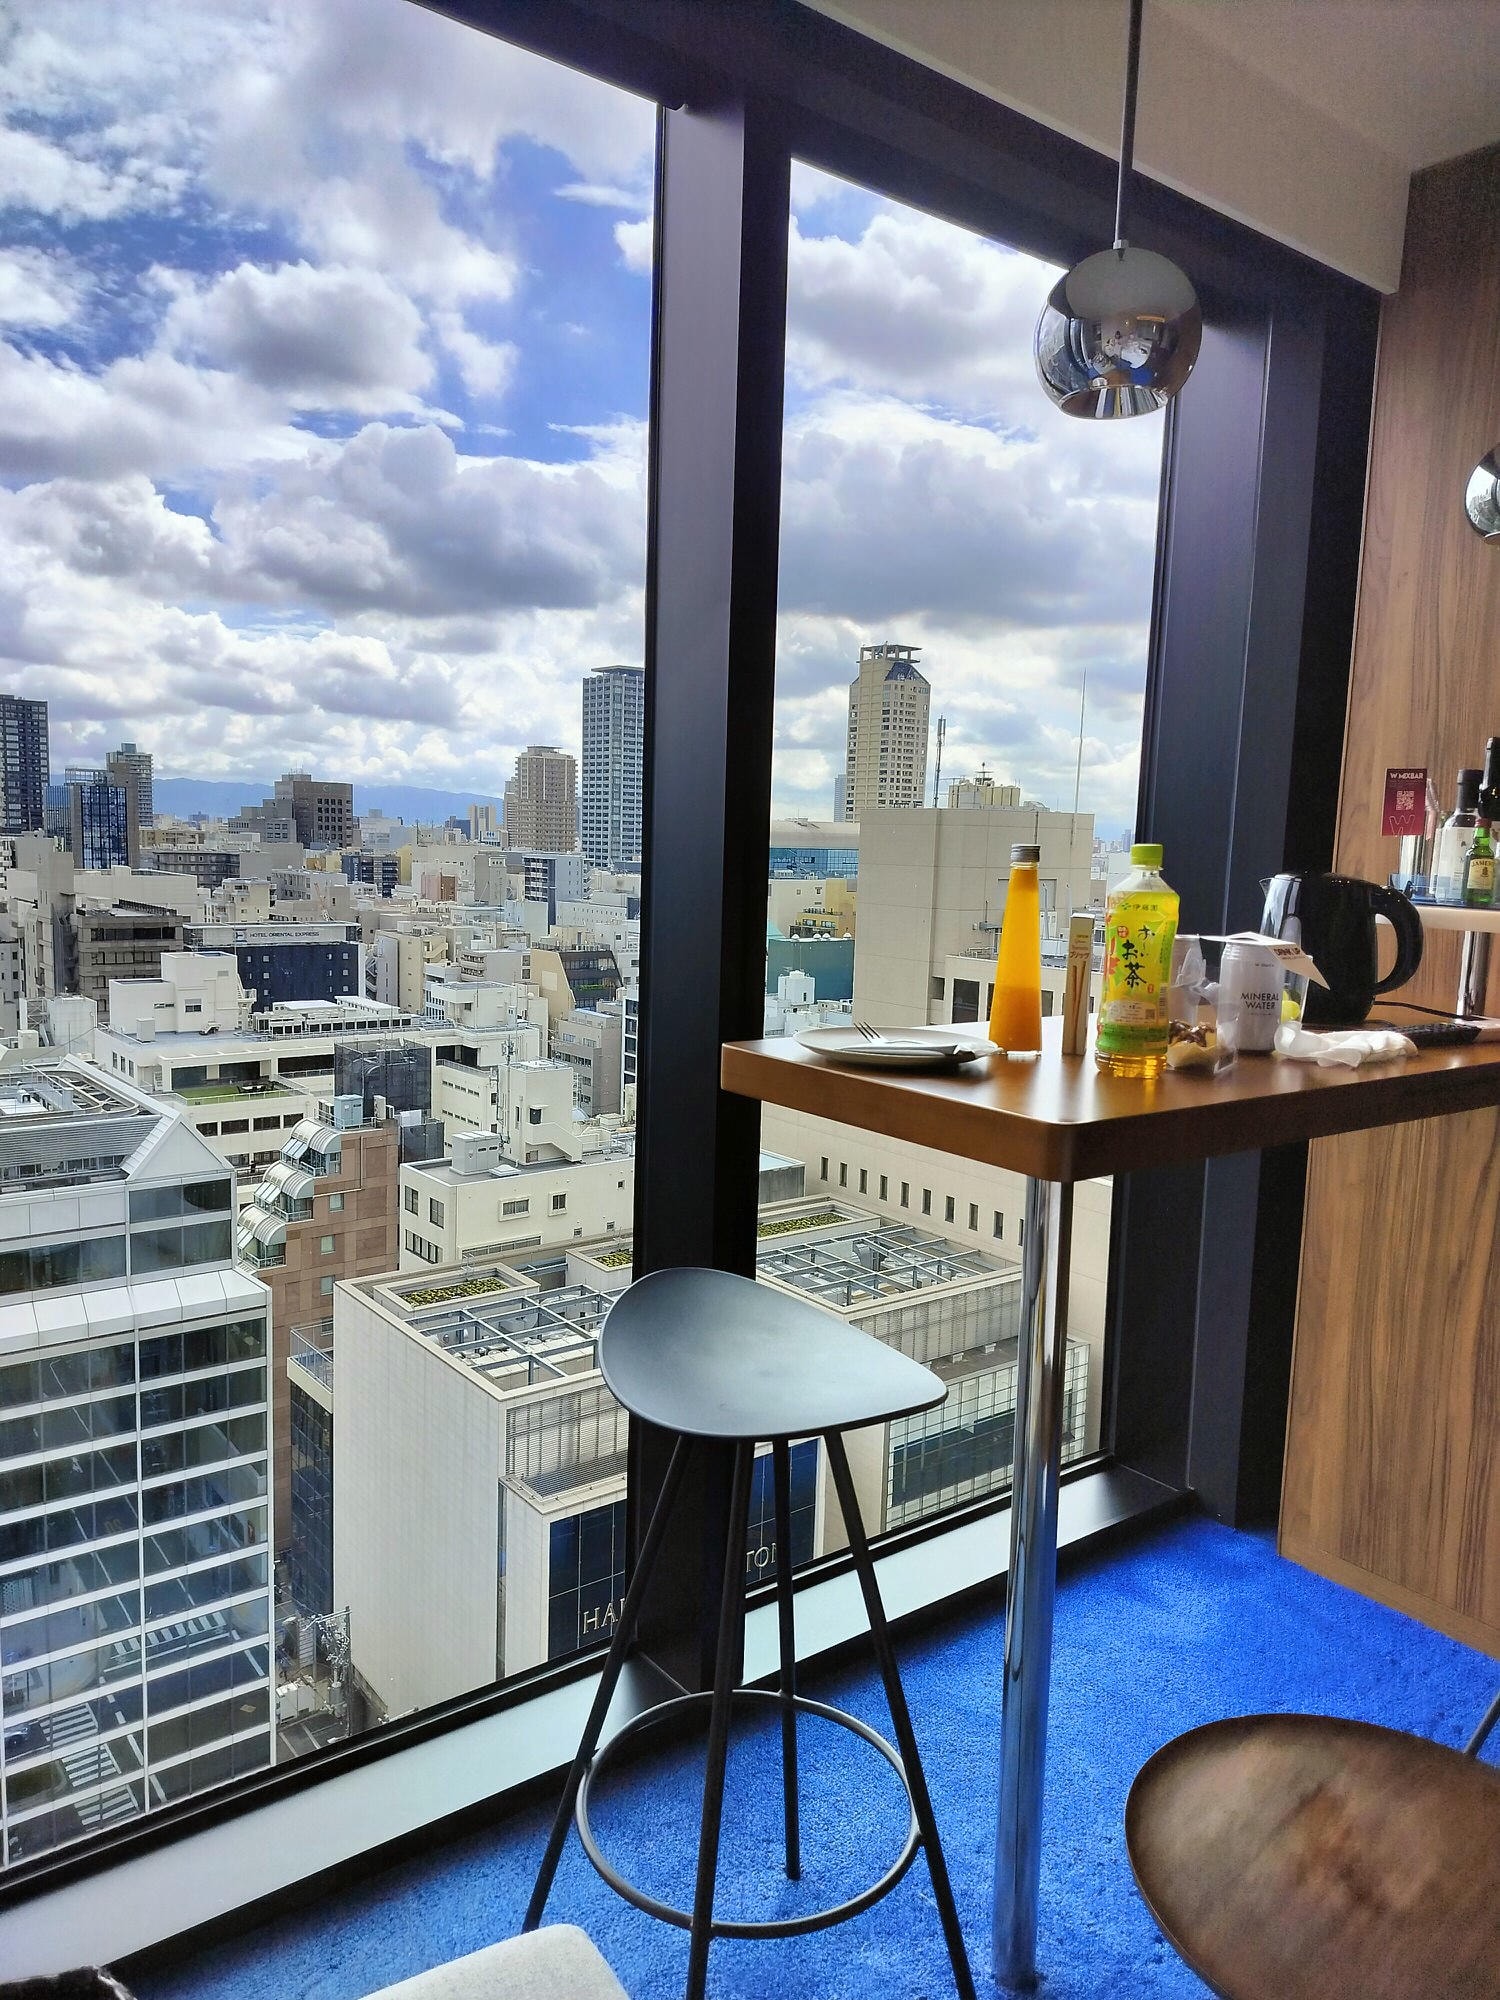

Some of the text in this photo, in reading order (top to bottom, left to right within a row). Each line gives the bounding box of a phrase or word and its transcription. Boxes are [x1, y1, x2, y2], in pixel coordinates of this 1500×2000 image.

[1398, 772, 1424, 780] MIXBAR
[1240, 992, 1279, 1001] MINERAL
[1245, 1001, 1275, 1010] WATER
